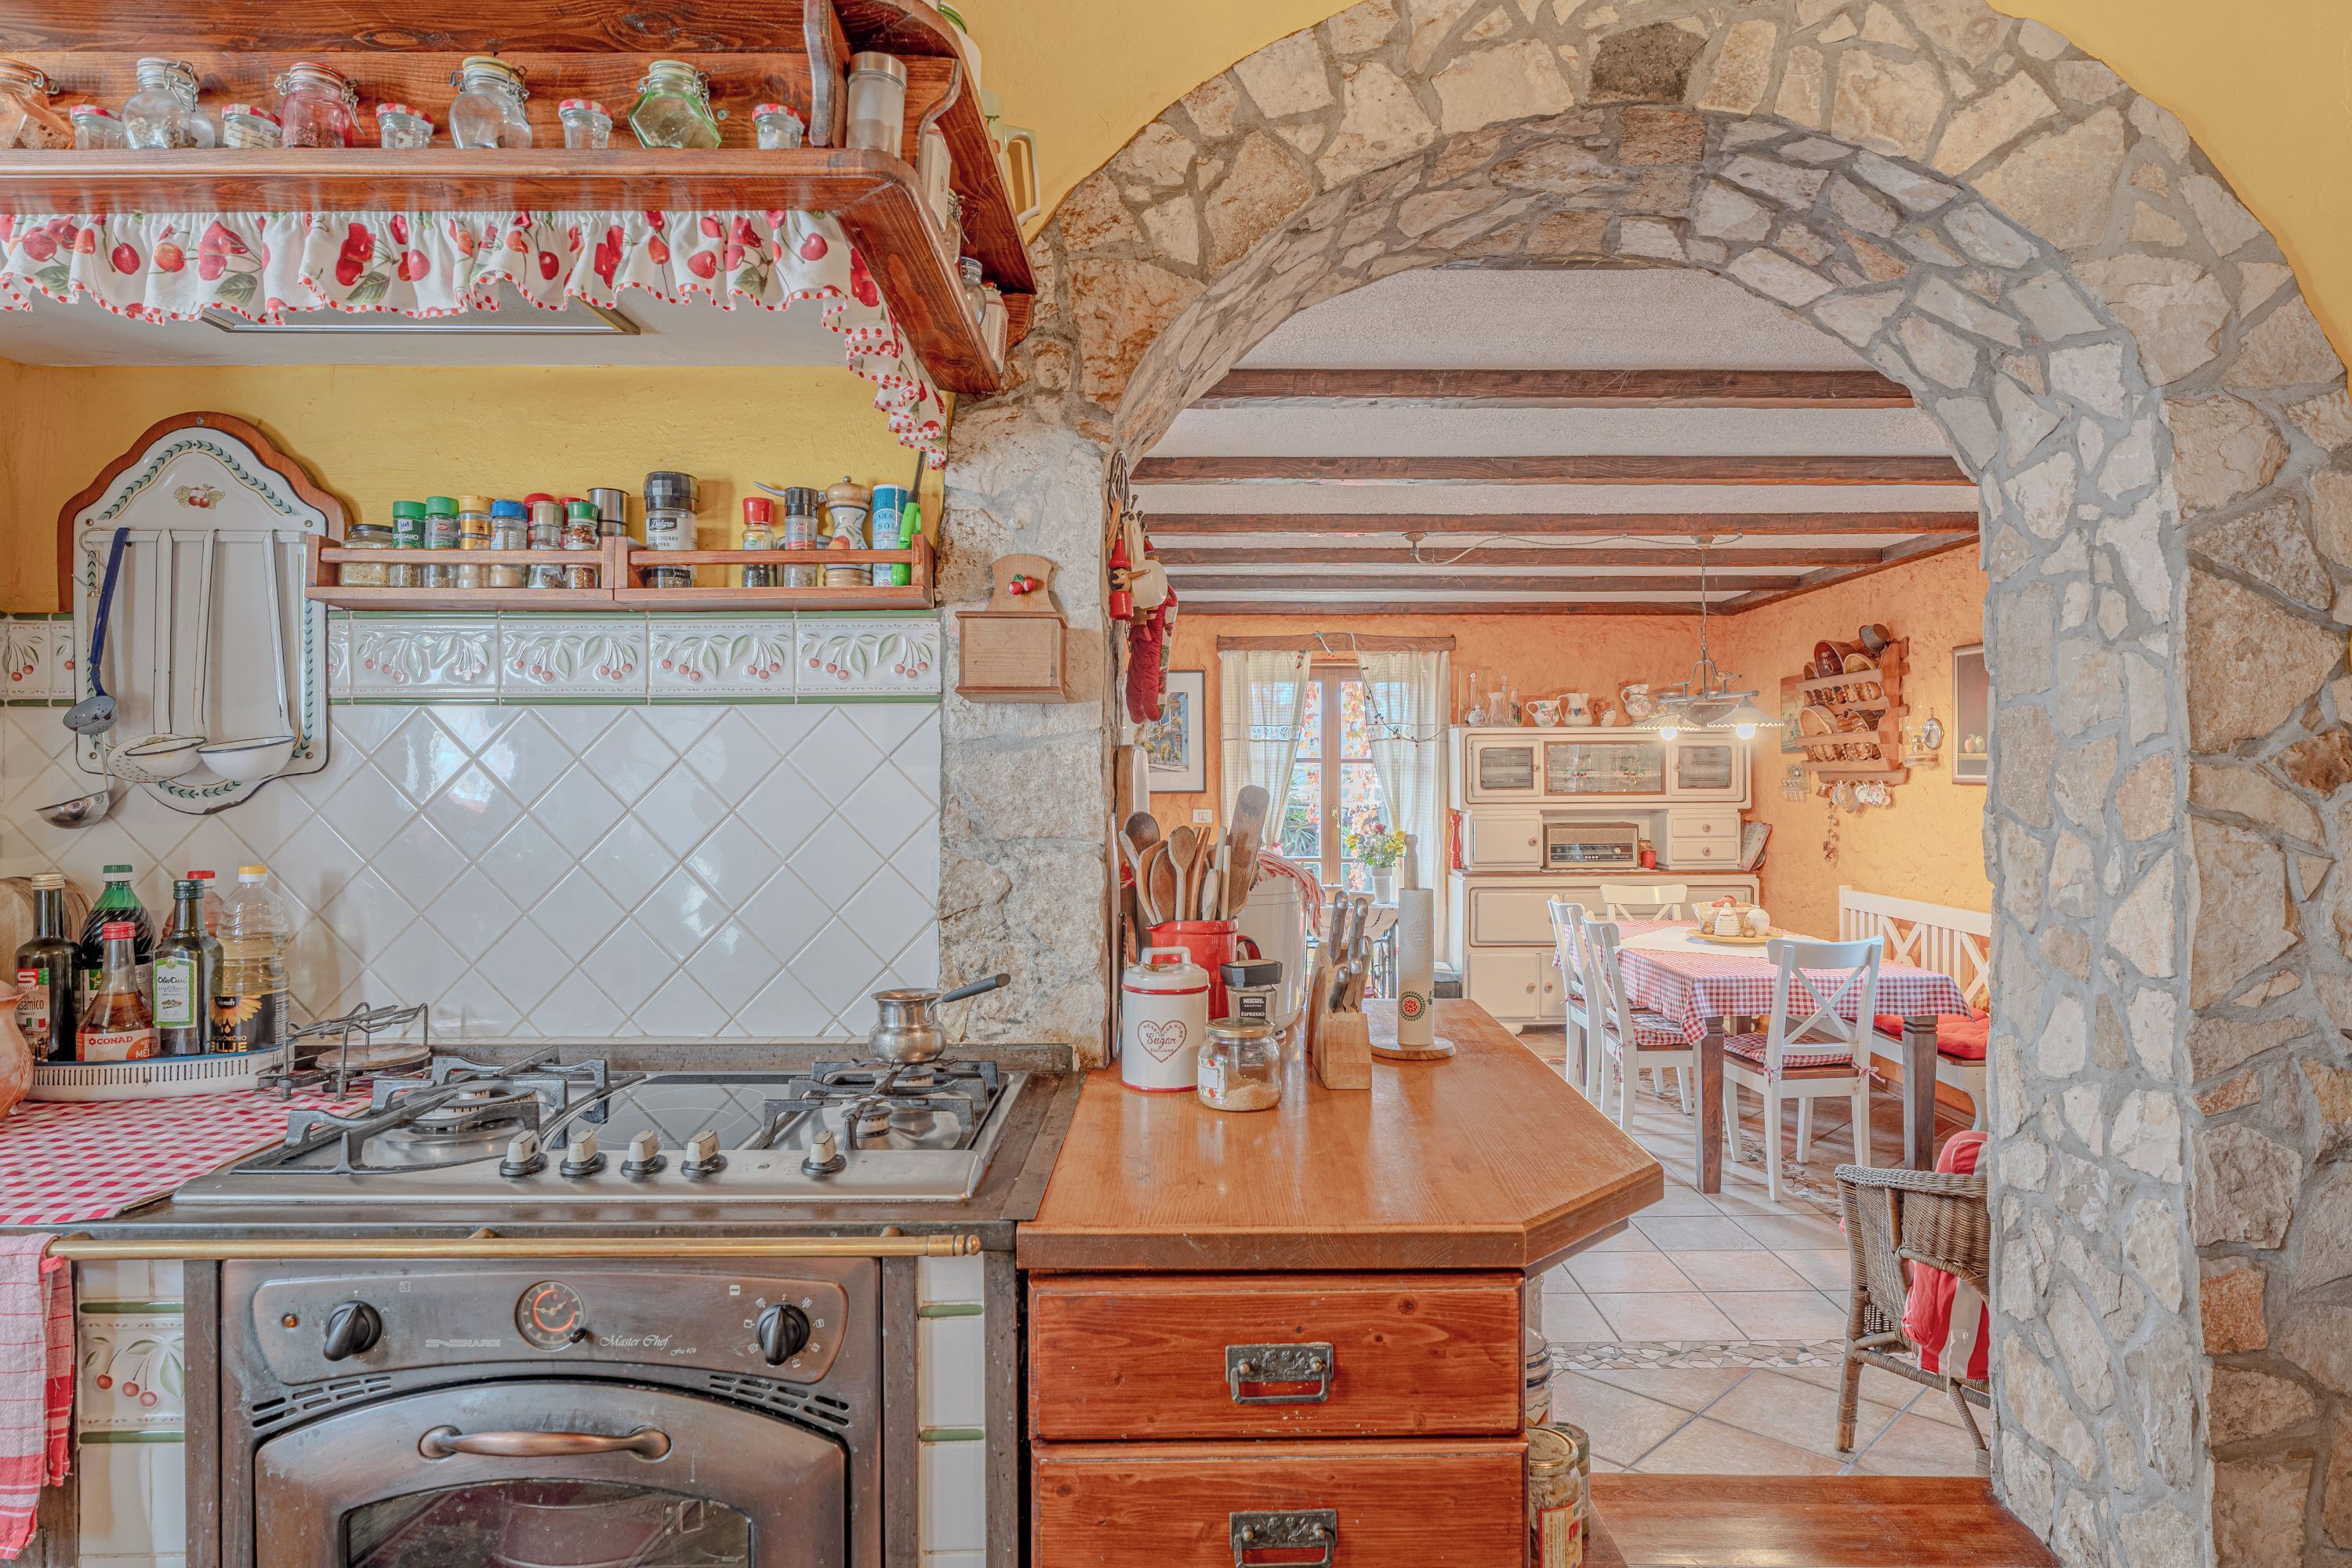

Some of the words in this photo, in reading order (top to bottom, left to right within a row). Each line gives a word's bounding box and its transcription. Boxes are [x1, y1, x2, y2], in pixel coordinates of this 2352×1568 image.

[650, 519, 675, 529] Deluxe
[1143, 1024, 1160, 1035] HEART
[96, 1036, 133, 1045] CONAD
[1146, 1033, 1177, 1049] Sugar
[599, 1334, 641, 1347] Master
[642, 1334, 673, 1351] Chef
